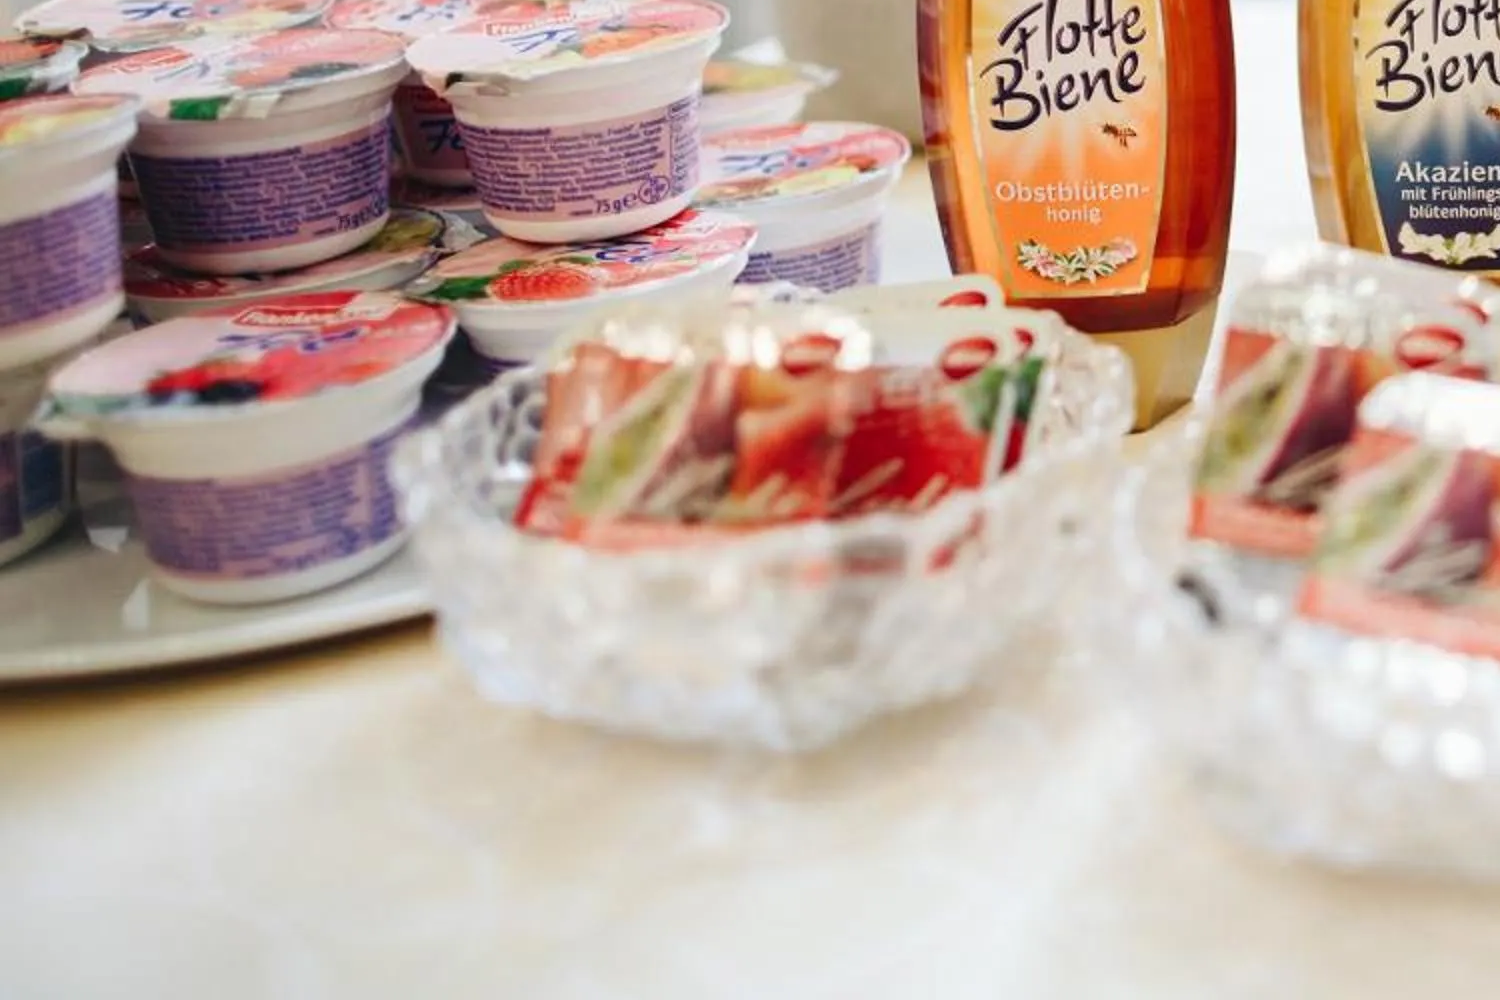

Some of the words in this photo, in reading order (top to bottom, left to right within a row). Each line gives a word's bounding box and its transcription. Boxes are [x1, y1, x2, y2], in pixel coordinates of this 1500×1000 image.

[980, 50, 1147, 131] Biene
[995, 180, 1150, 202] Obstblüten-
[1401, 186, 1427, 201] mit
[1046, 205, 1103, 224] honig
